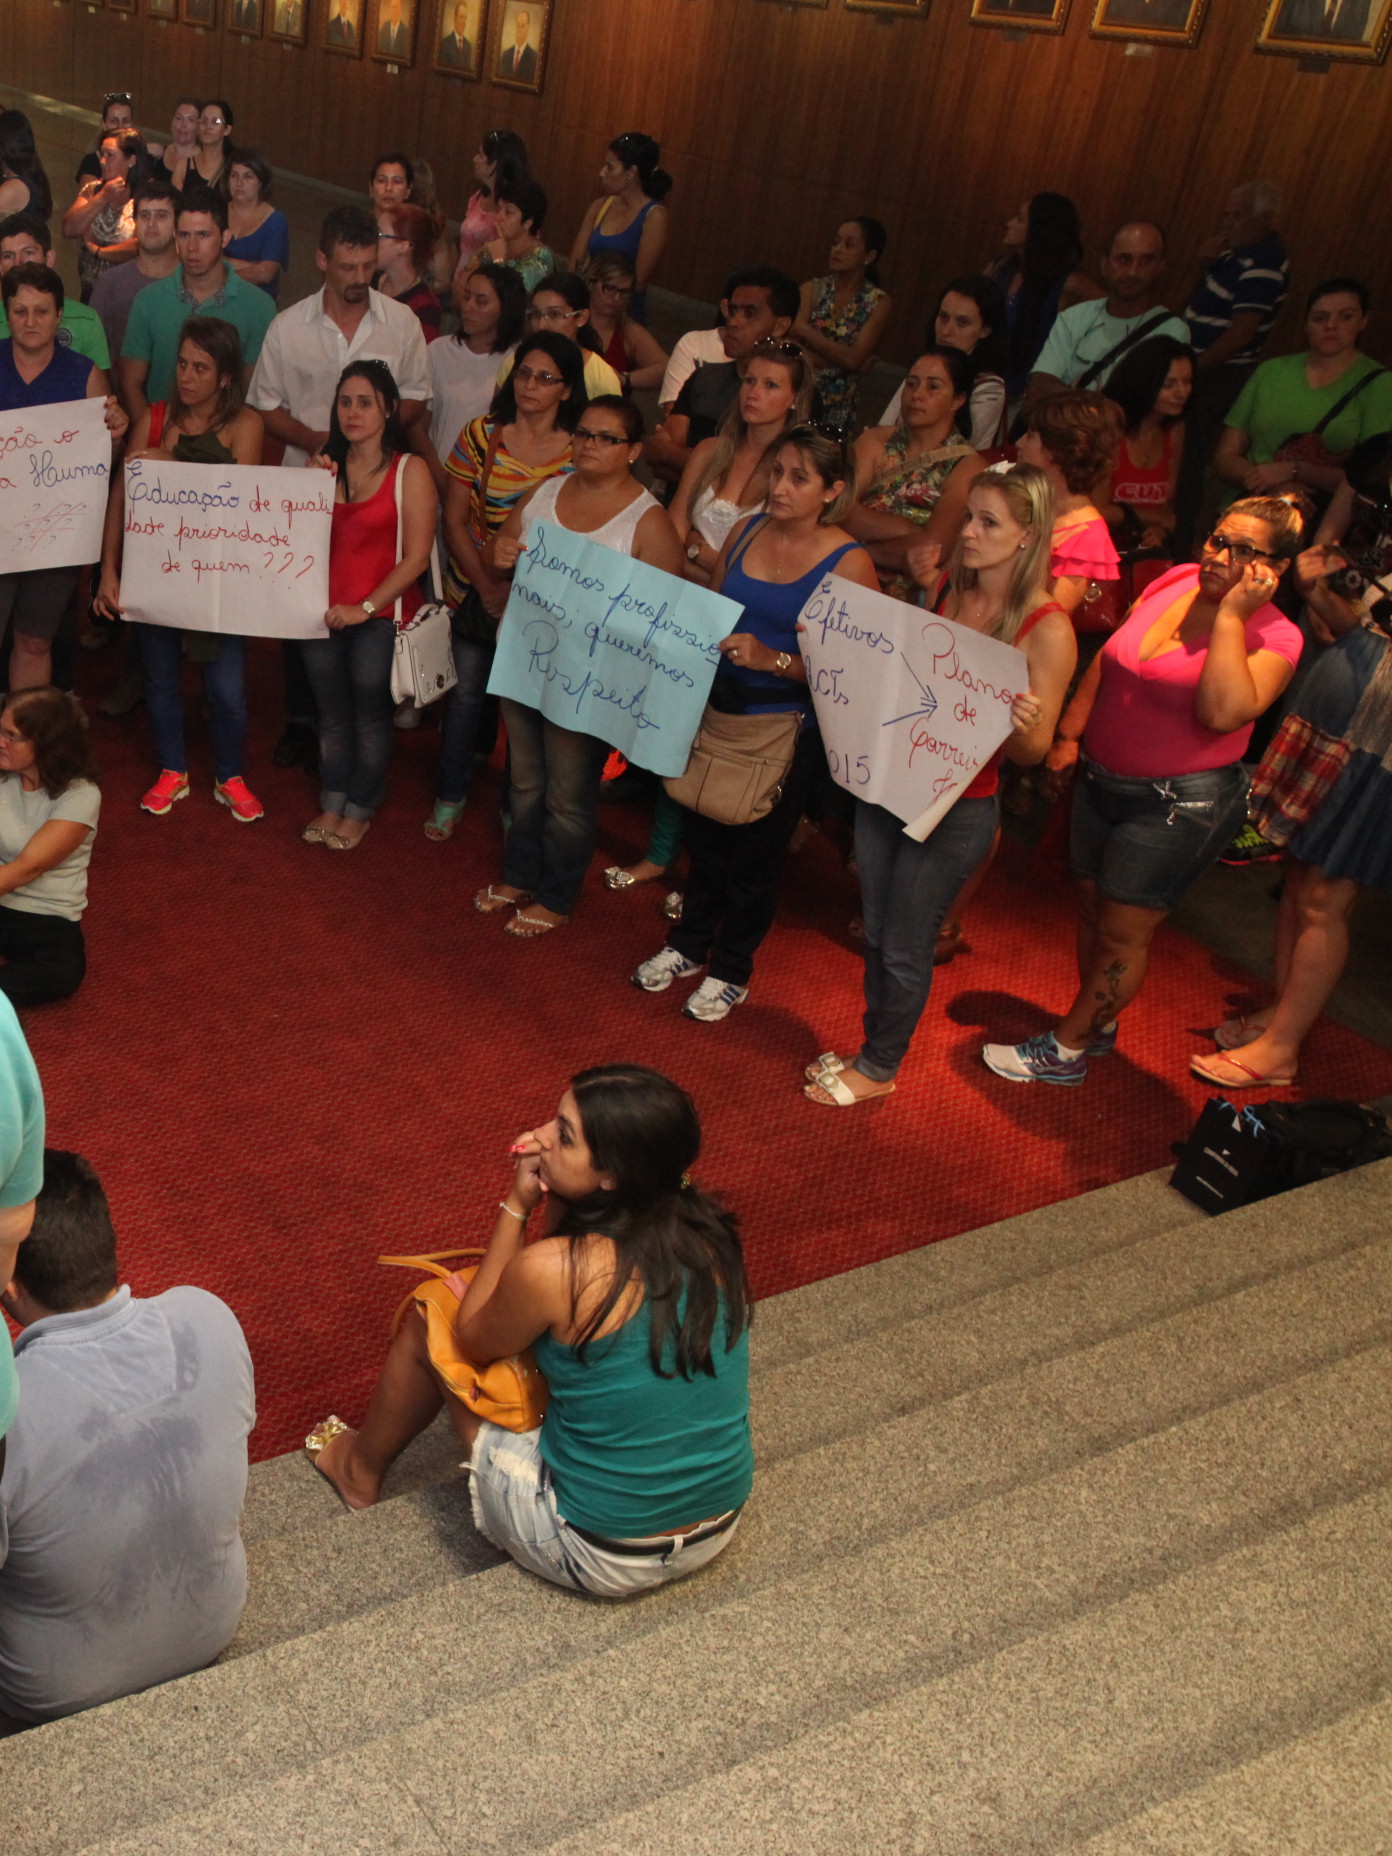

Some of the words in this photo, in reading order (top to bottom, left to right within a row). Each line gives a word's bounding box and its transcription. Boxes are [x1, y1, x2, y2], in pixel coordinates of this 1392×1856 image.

[126, 460, 240, 514] Educação
[248, 485, 271, 513] de
[173, 515, 291, 551] prioridade
[526, 526, 605, 592] Somos
[161, 550, 181, 574] de
[191, 559, 250, 585] quem
[804, 581, 895, 654] Efetivos
[522, 619, 661, 730] Respeito
[584, 621, 695, 688] queremos
[921, 622, 1013, 705] Plano
[953, 694, 978, 727] de
